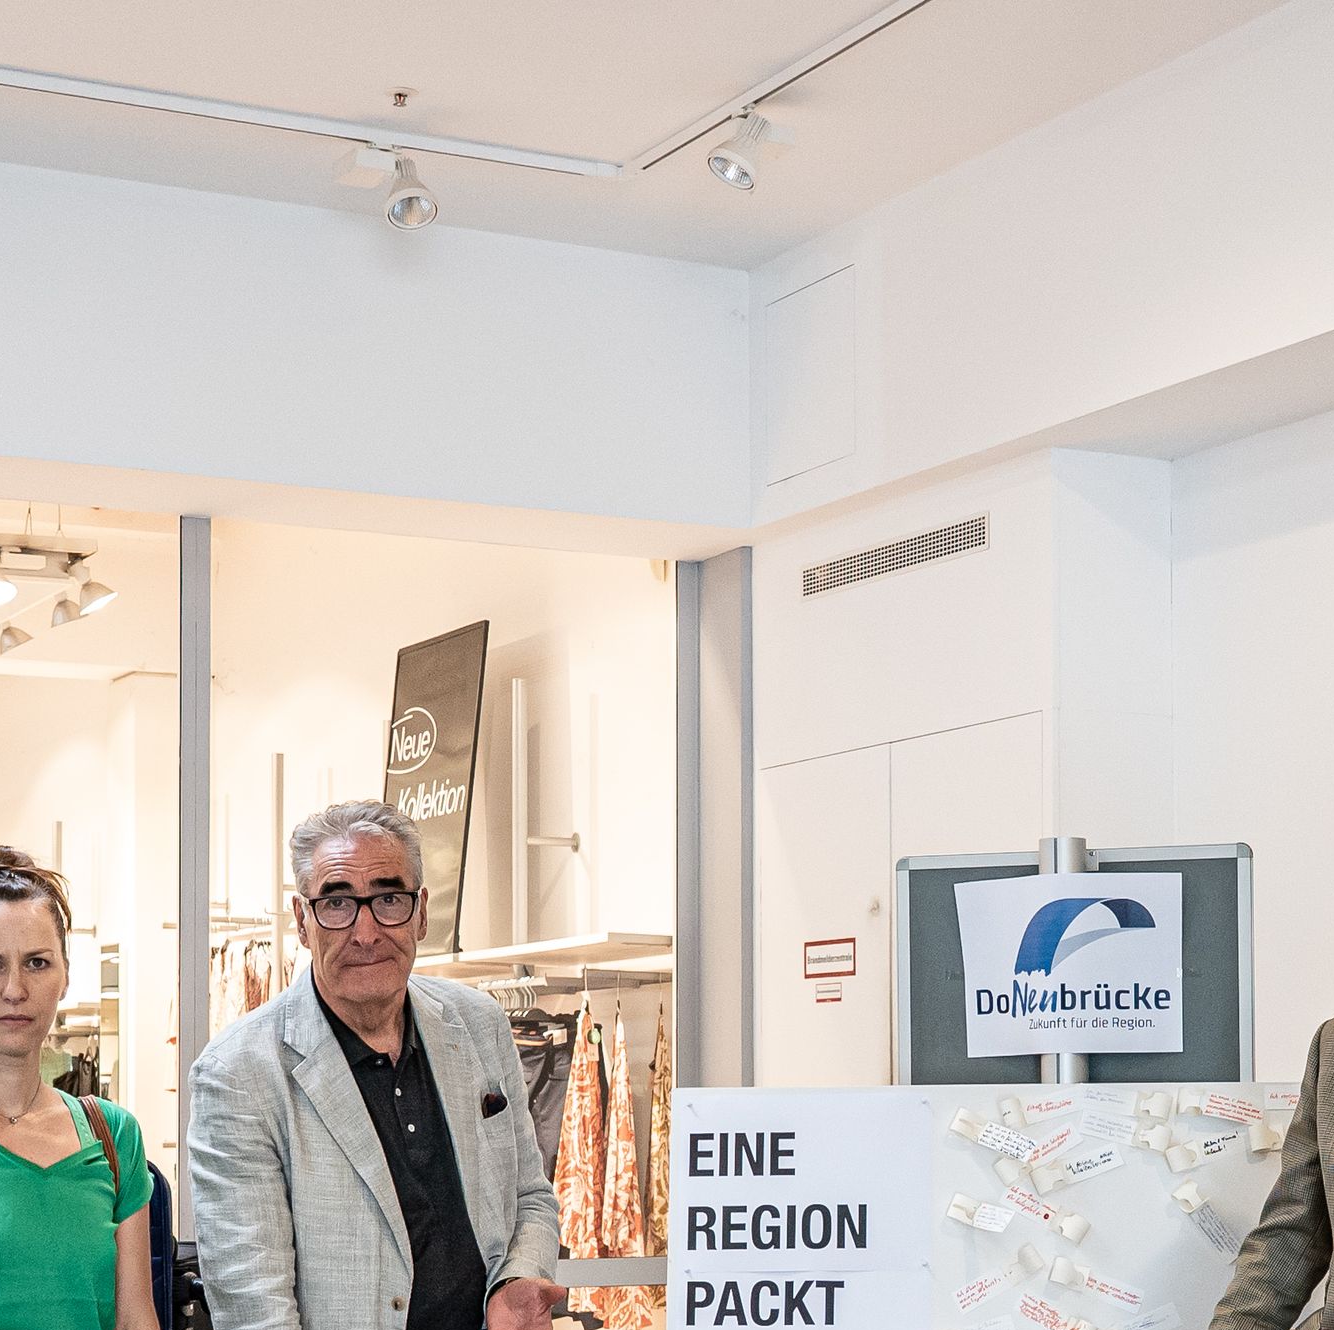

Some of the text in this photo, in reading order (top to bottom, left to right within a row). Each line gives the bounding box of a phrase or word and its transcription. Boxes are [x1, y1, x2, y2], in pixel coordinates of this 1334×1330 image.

[390, 726, 431, 765] Neue
[397, 778, 466, 821] Kollektion
[1028, 1015, 1156, 1031] Zukunft für die Region.
[688, 1131, 796, 1177] EINE
[686, 1203, 868, 1251] REGION
[685, 1280, 845, 1327] PACKT
